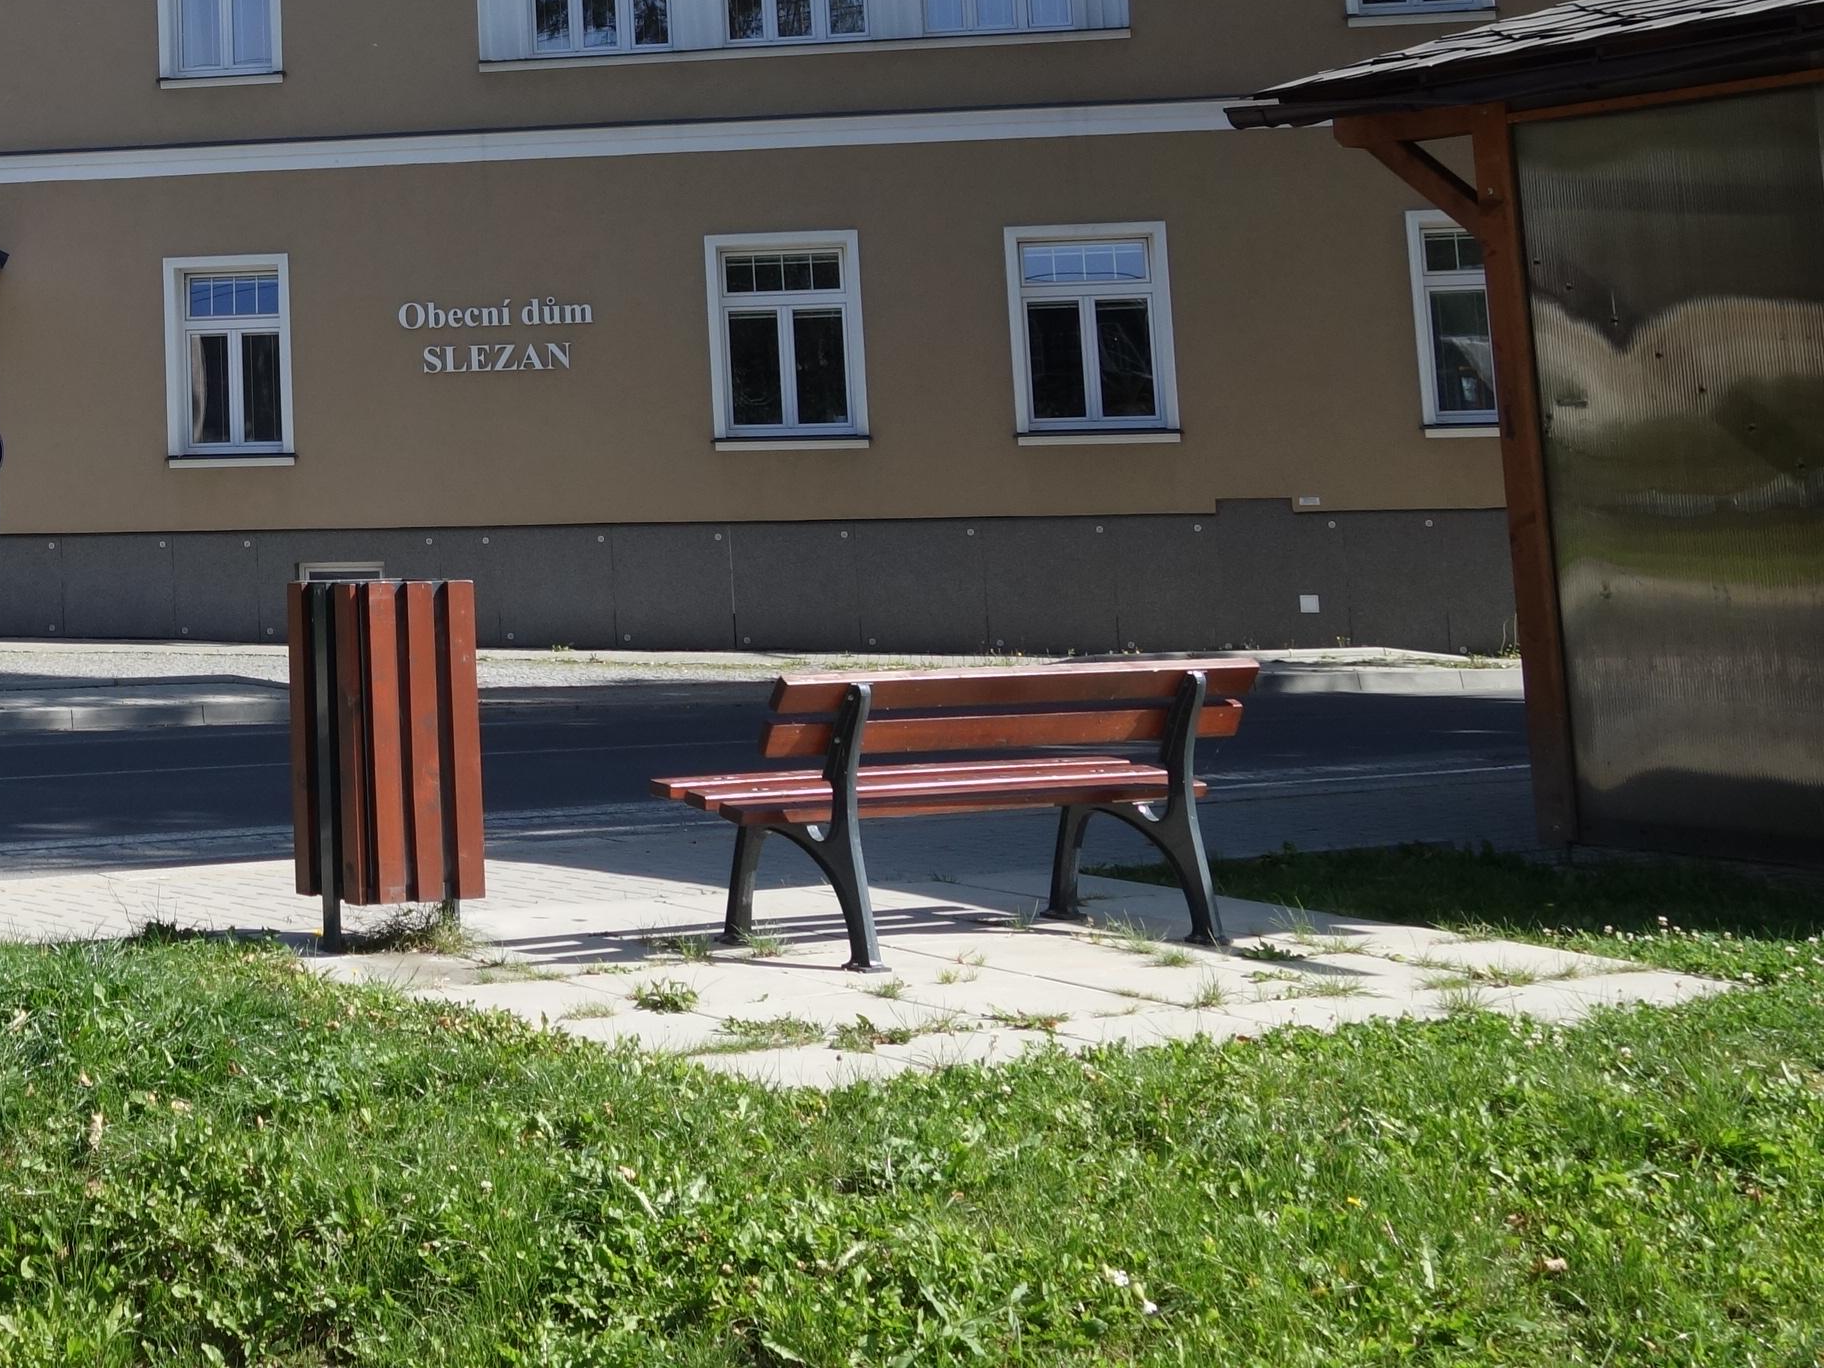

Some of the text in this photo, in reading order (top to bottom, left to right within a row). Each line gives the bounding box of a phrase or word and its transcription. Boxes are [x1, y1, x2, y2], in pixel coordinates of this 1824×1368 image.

[398, 296, 593, 330] Obecní dům
[423, 342, 572, 374] SLEZAN
